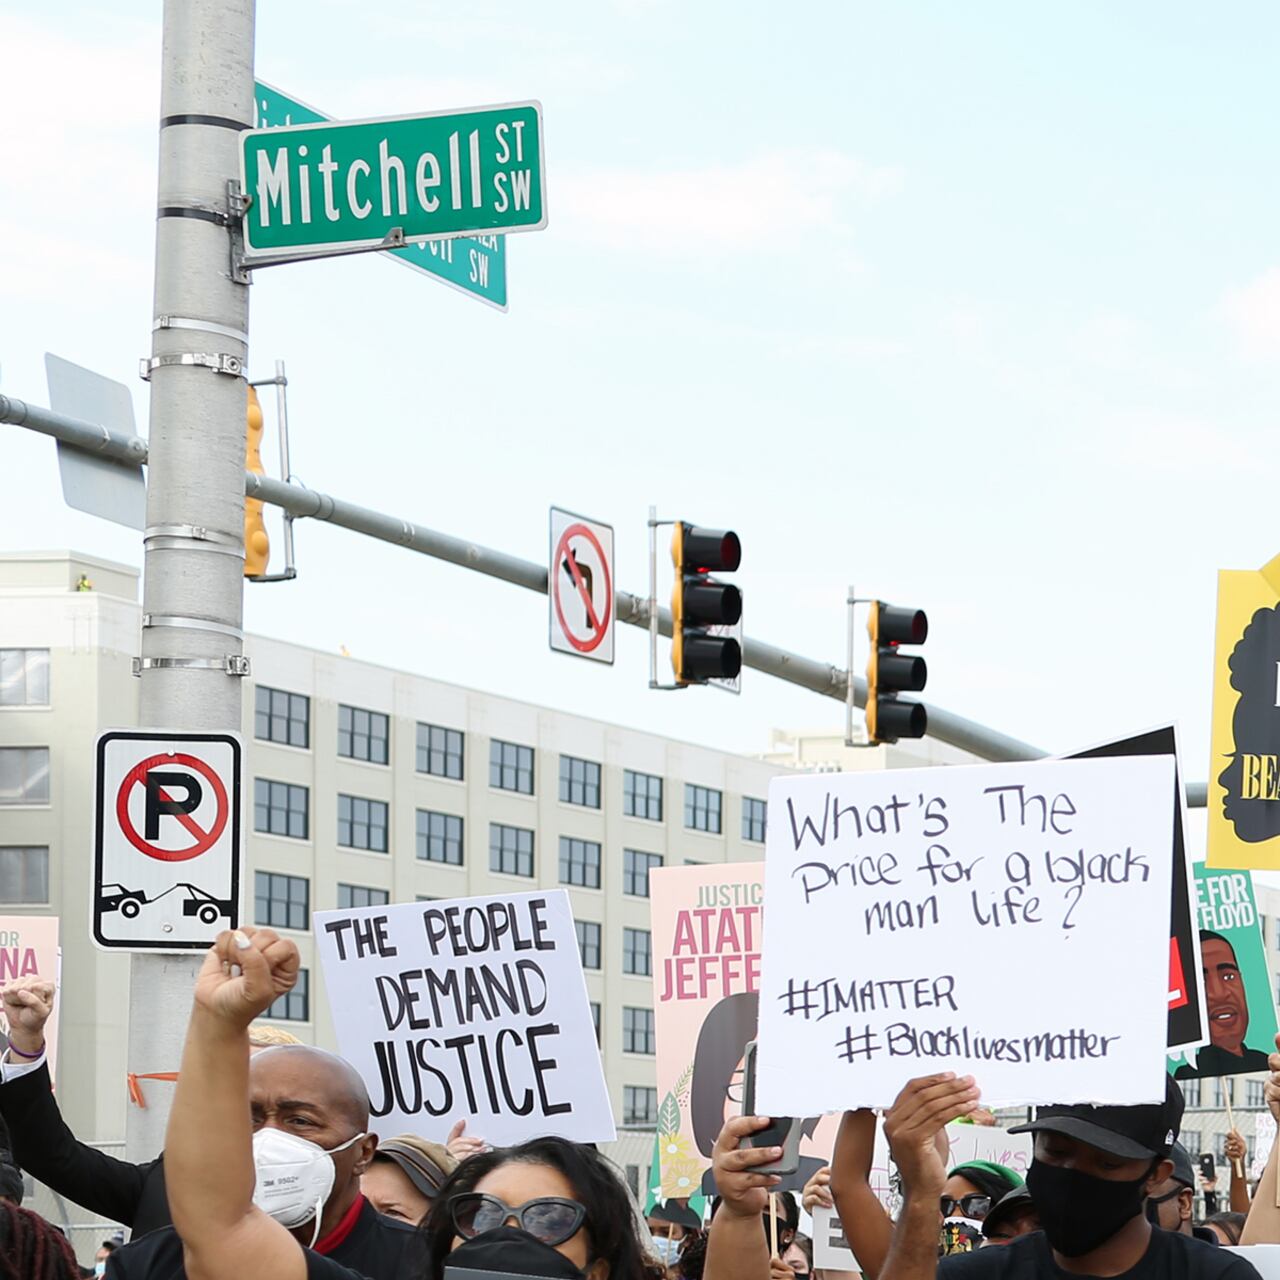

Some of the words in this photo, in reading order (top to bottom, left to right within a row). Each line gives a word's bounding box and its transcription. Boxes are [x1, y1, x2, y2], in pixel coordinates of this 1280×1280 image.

[494, 121, 525, 164] ST
[256, 129, 482, 227] Mitchell
[493, 169, 531, 213] SW
[468, 248, 489, 288] SW
[787, 792, 951, 850] What's
[984, 784, 1078, 835] The
[917, 843, 979, 888] for
[1005, 852, 1033, 884] a
[1045, 845, 1150, 887] black
[1207, 874, 1250, 904] FOR
[325, 914, 397, 961] THE
[425, 899, 556, 957] PEOPLE
[673, 906, 764, 956] ATAT
[865, 891, 941, 935] man
[1202, 901, 1255, 931] FLOYD
[377, 959, 547, 1031] DEMAND
[778, 975, 957, 1022] #IMATTER
[371, 1022, 573, 1120] JUSTICE
